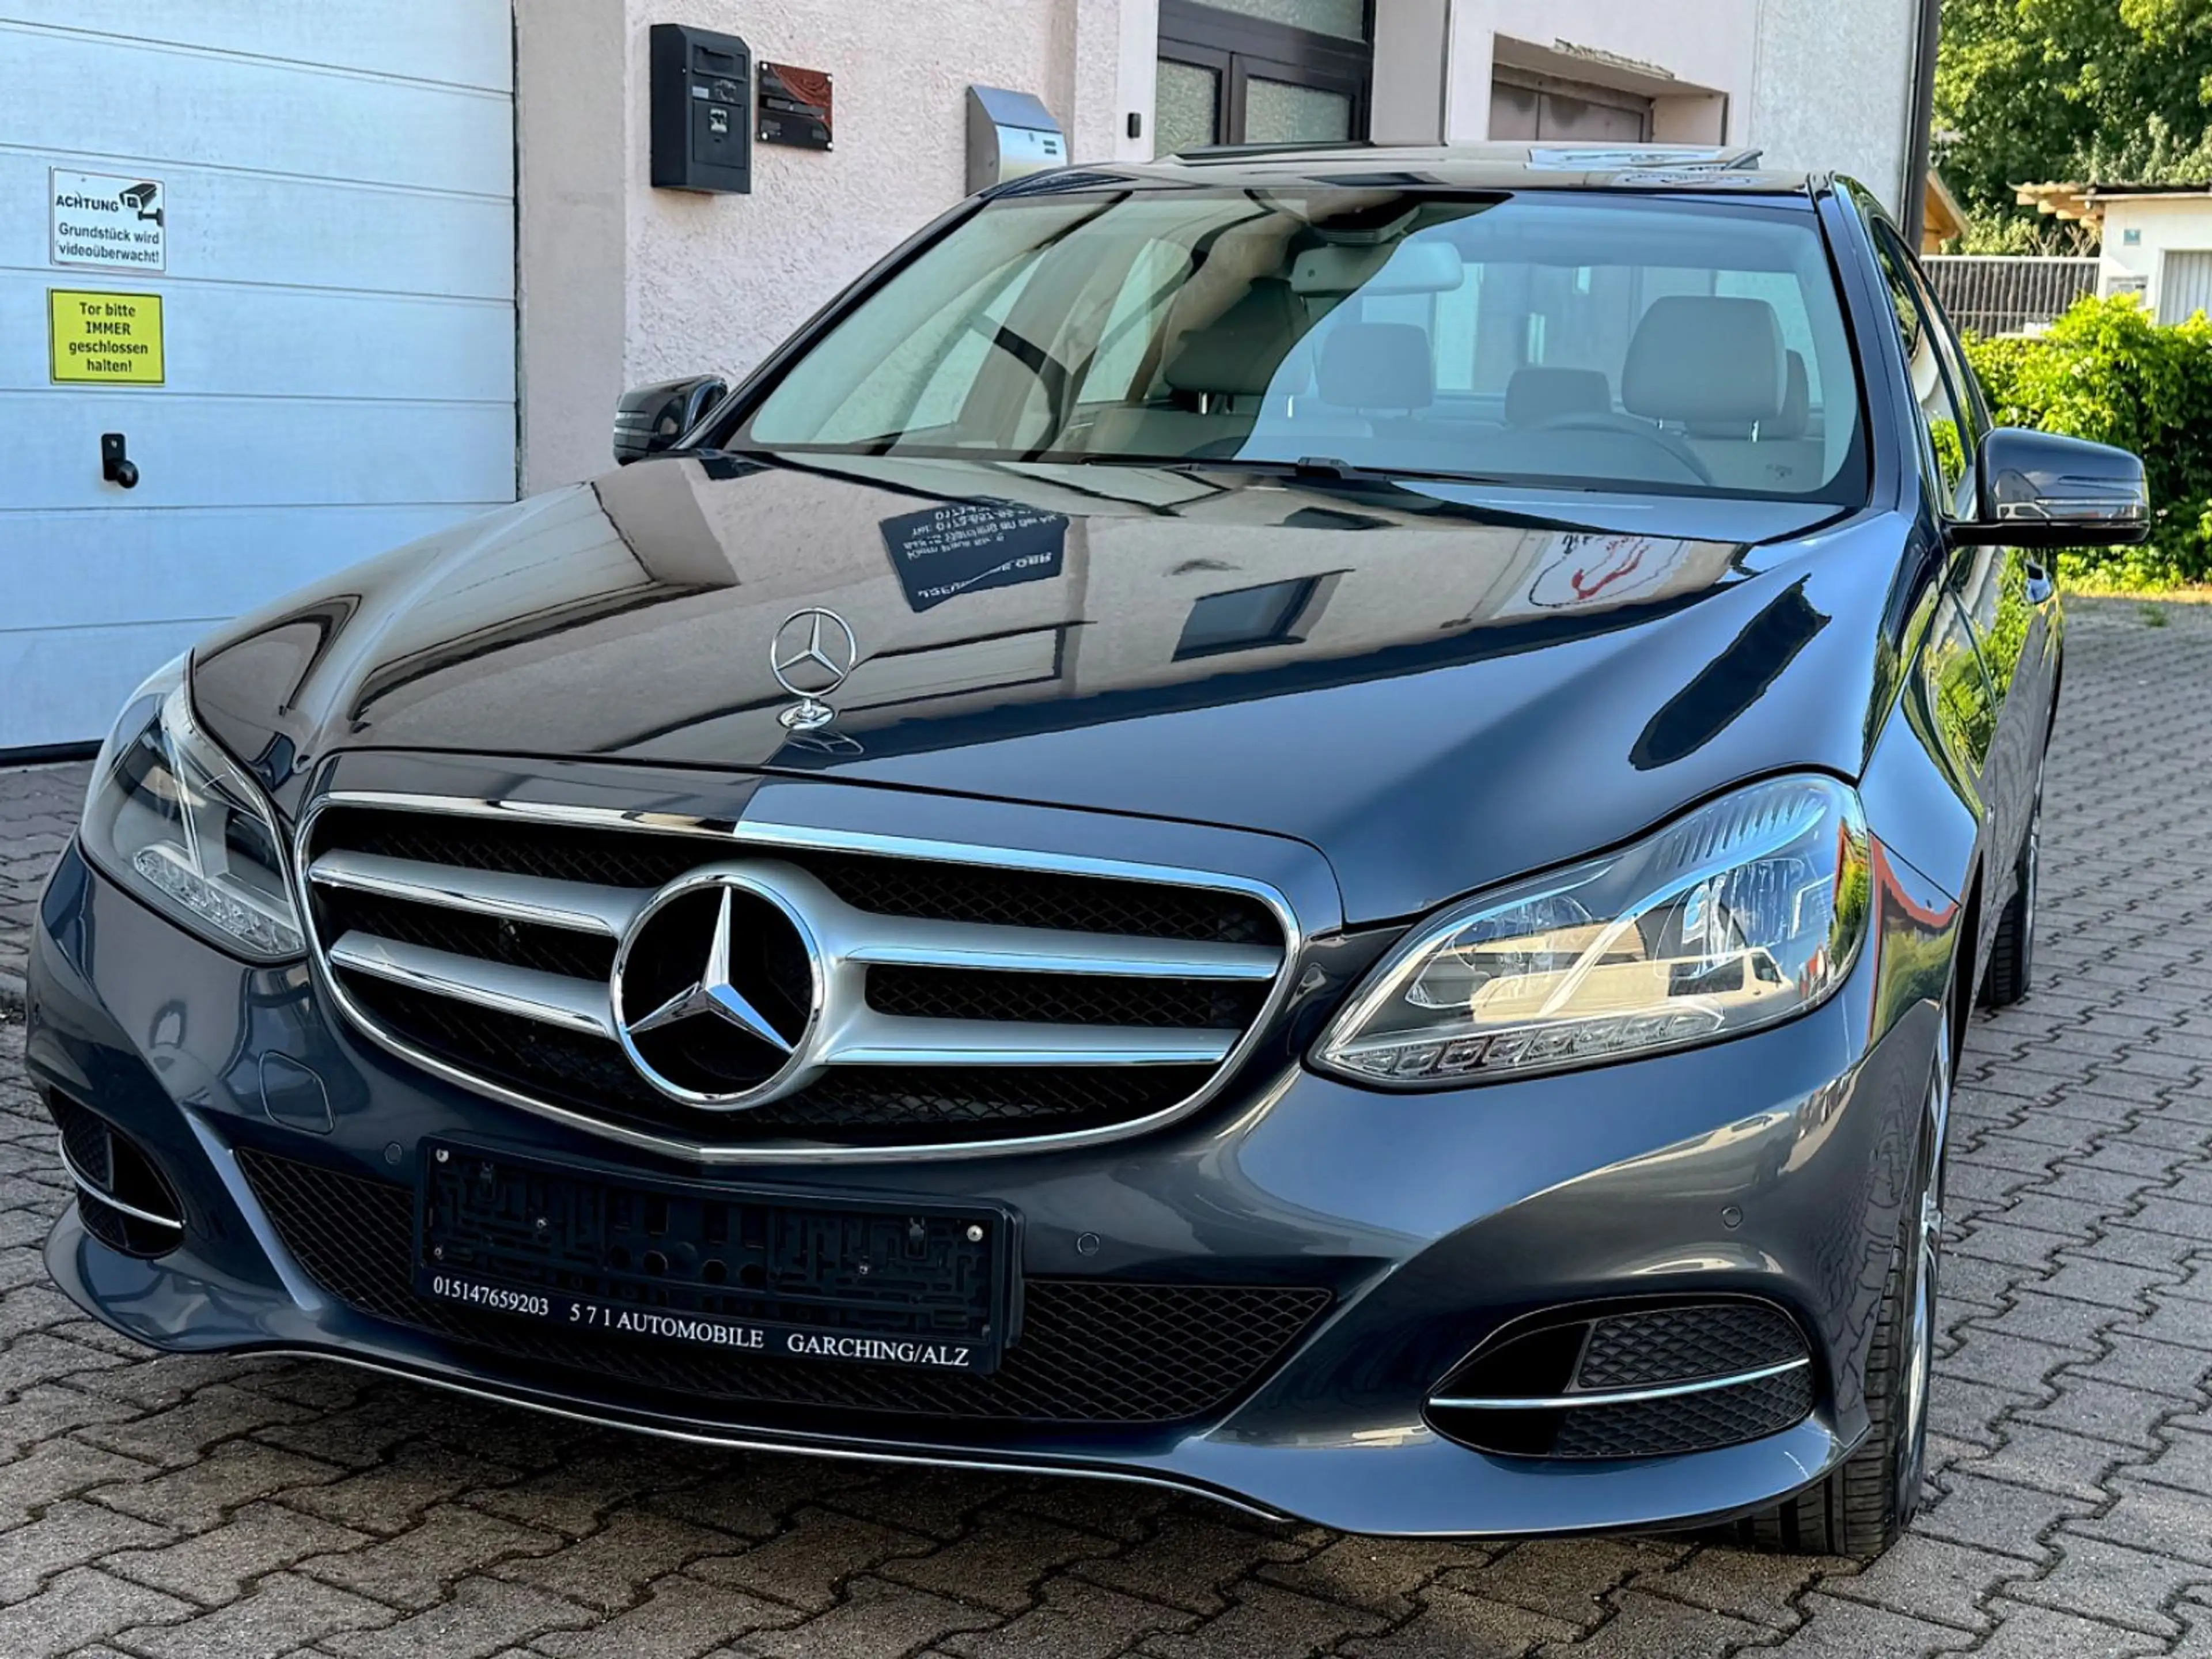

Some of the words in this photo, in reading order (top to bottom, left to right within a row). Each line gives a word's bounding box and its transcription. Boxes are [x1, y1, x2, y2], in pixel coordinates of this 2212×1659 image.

[56, 195, 119, 213] ACHTUNG
[58, 222, 131, 243] Grundstück
[133, 231, 160, 245] wird
[58, 242, 160, 263] videoüberwacht!
[79, 302, 102, 316] Tor
[105, 302, 136, 317] bitte
[85, 321, 131, 336] IMMER
[69, 340, 149, 355] geschlossen
[86, 358, 132, 373] halten!
[433, 1275, 549, 1316] 015147659203
[616, 1312, 764, 1349] AUTOMOBILE
[787, 1333, 969, 1366] GARCHING/ALZ
